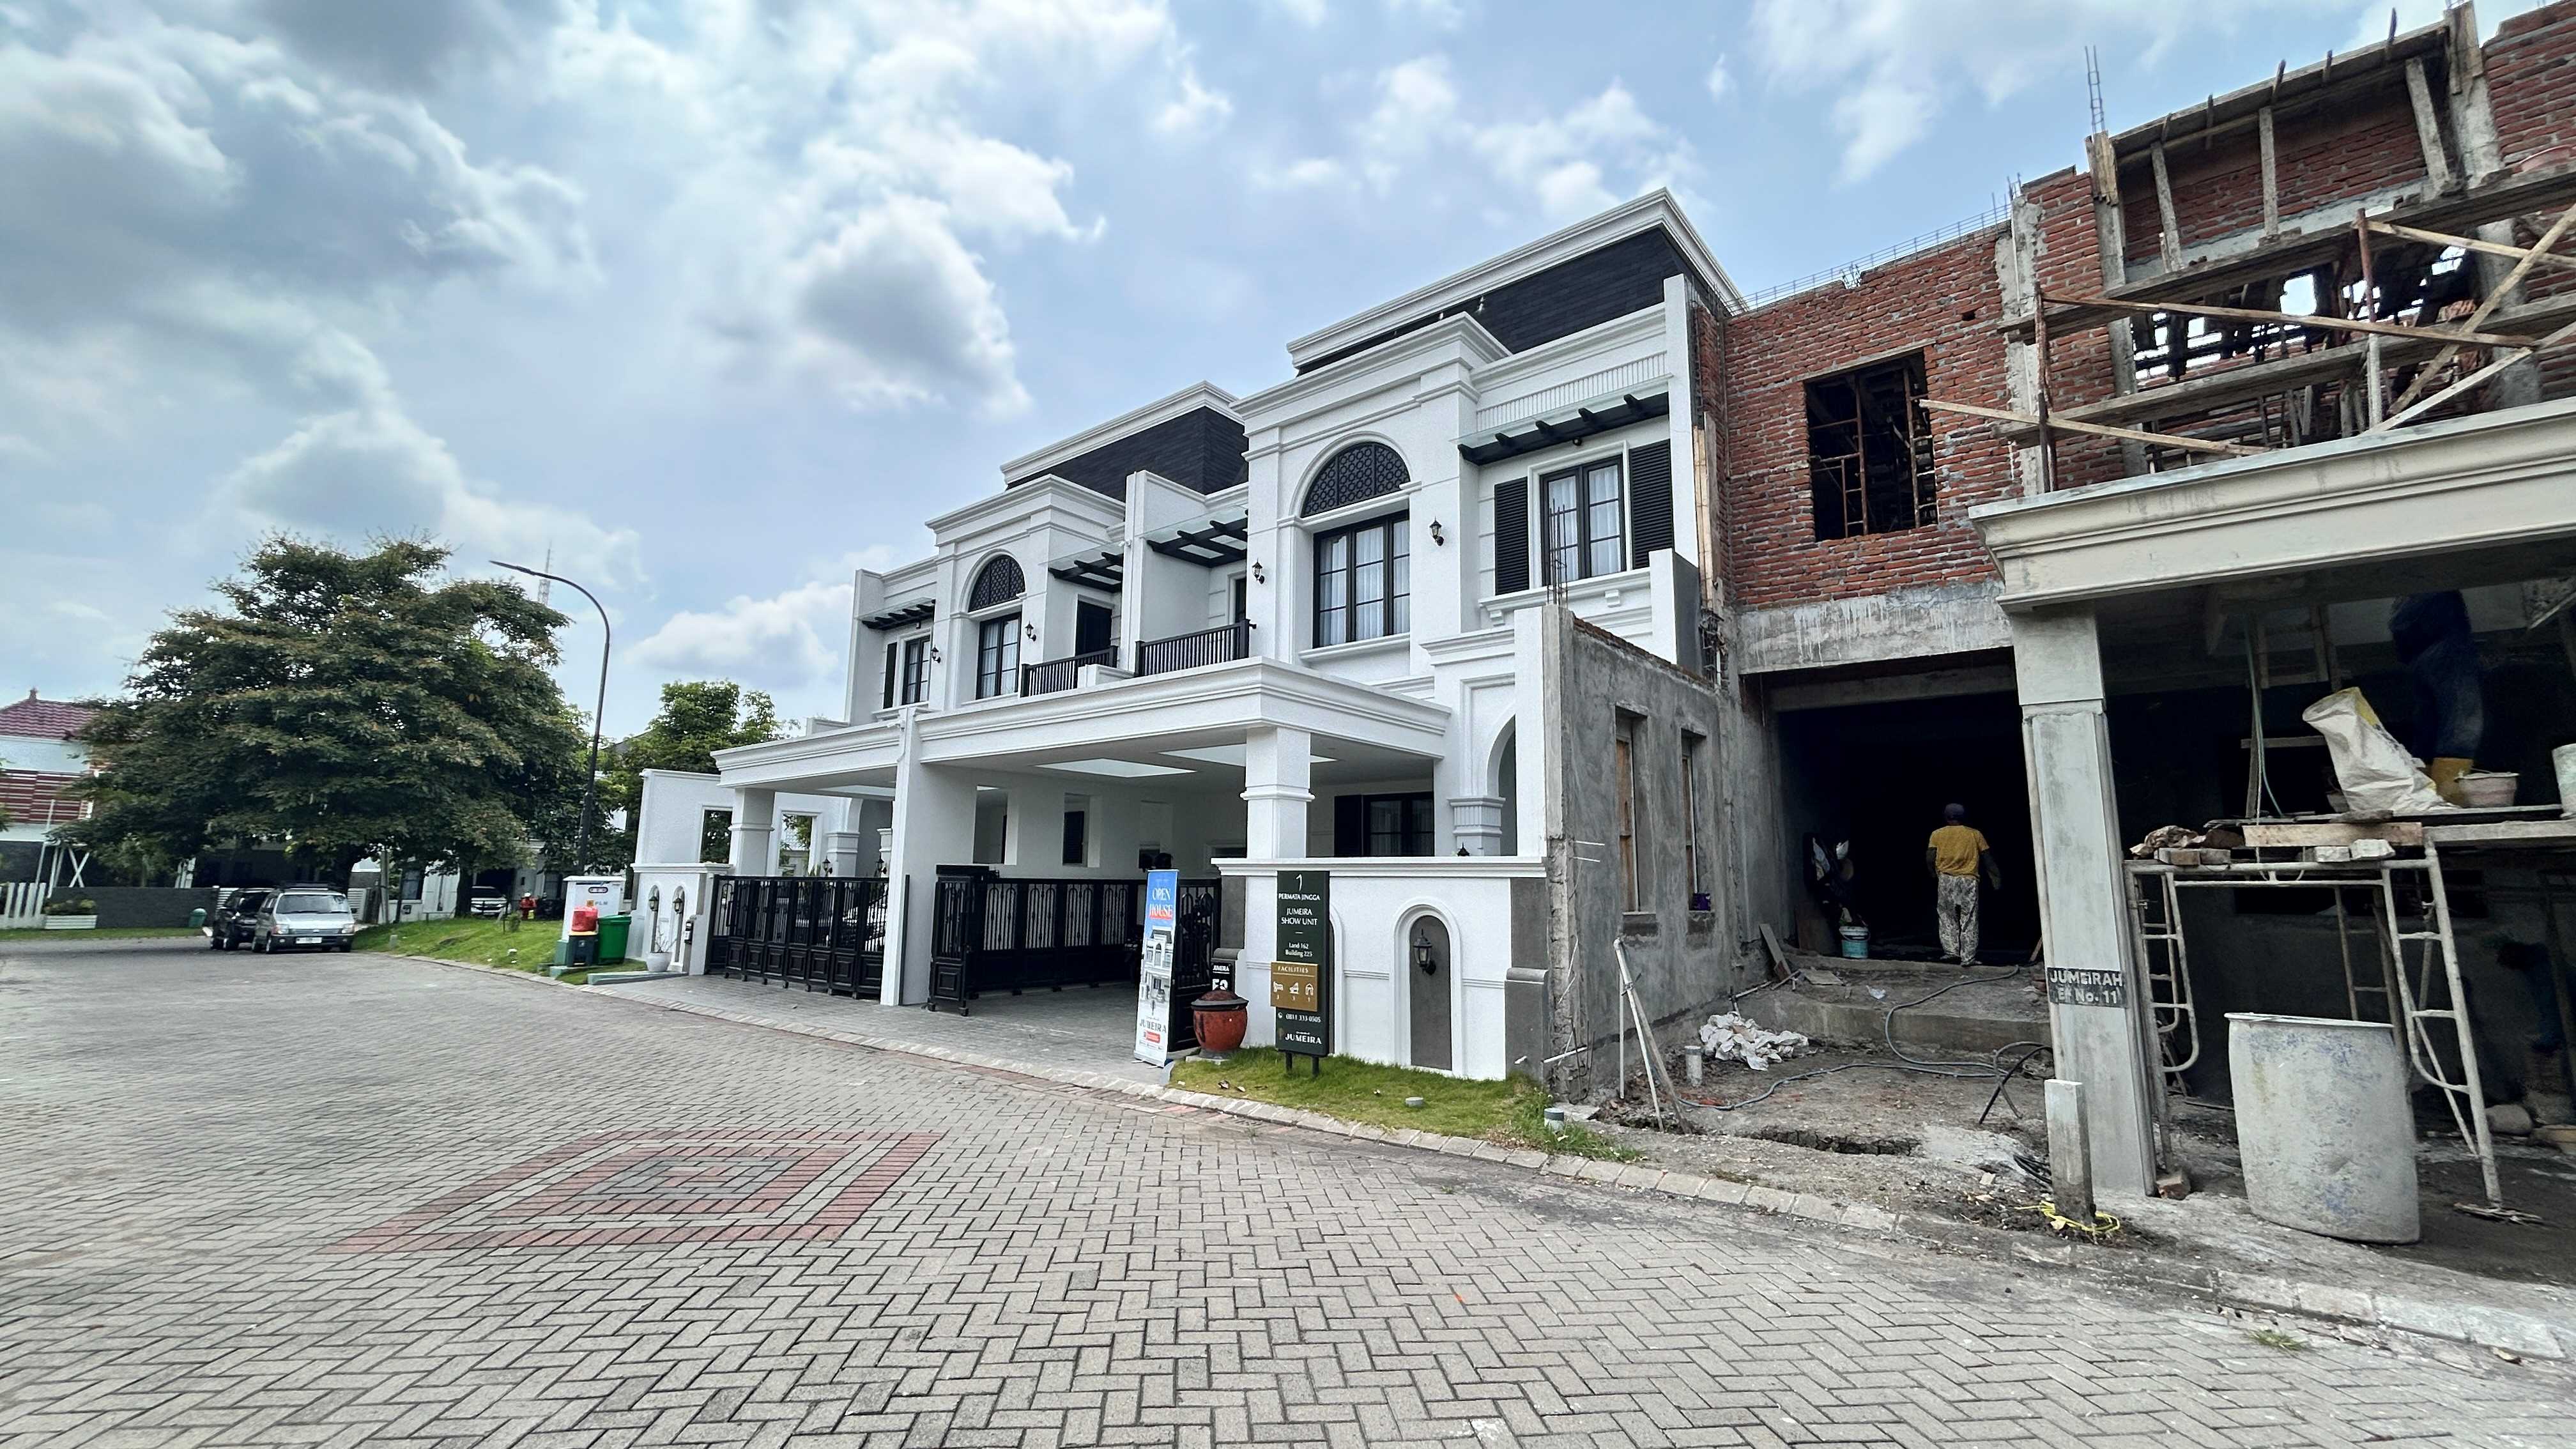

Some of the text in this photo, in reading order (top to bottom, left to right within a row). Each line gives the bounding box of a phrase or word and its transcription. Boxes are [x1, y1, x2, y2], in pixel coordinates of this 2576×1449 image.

[1153, 887, 1170, 900] OPEN
[1149, 903, 1173, 917] HOUSE
[1278, 965, 1309, 974] FACILITIES
[1285, 1033, 1322, 1045] JUMEIRA
